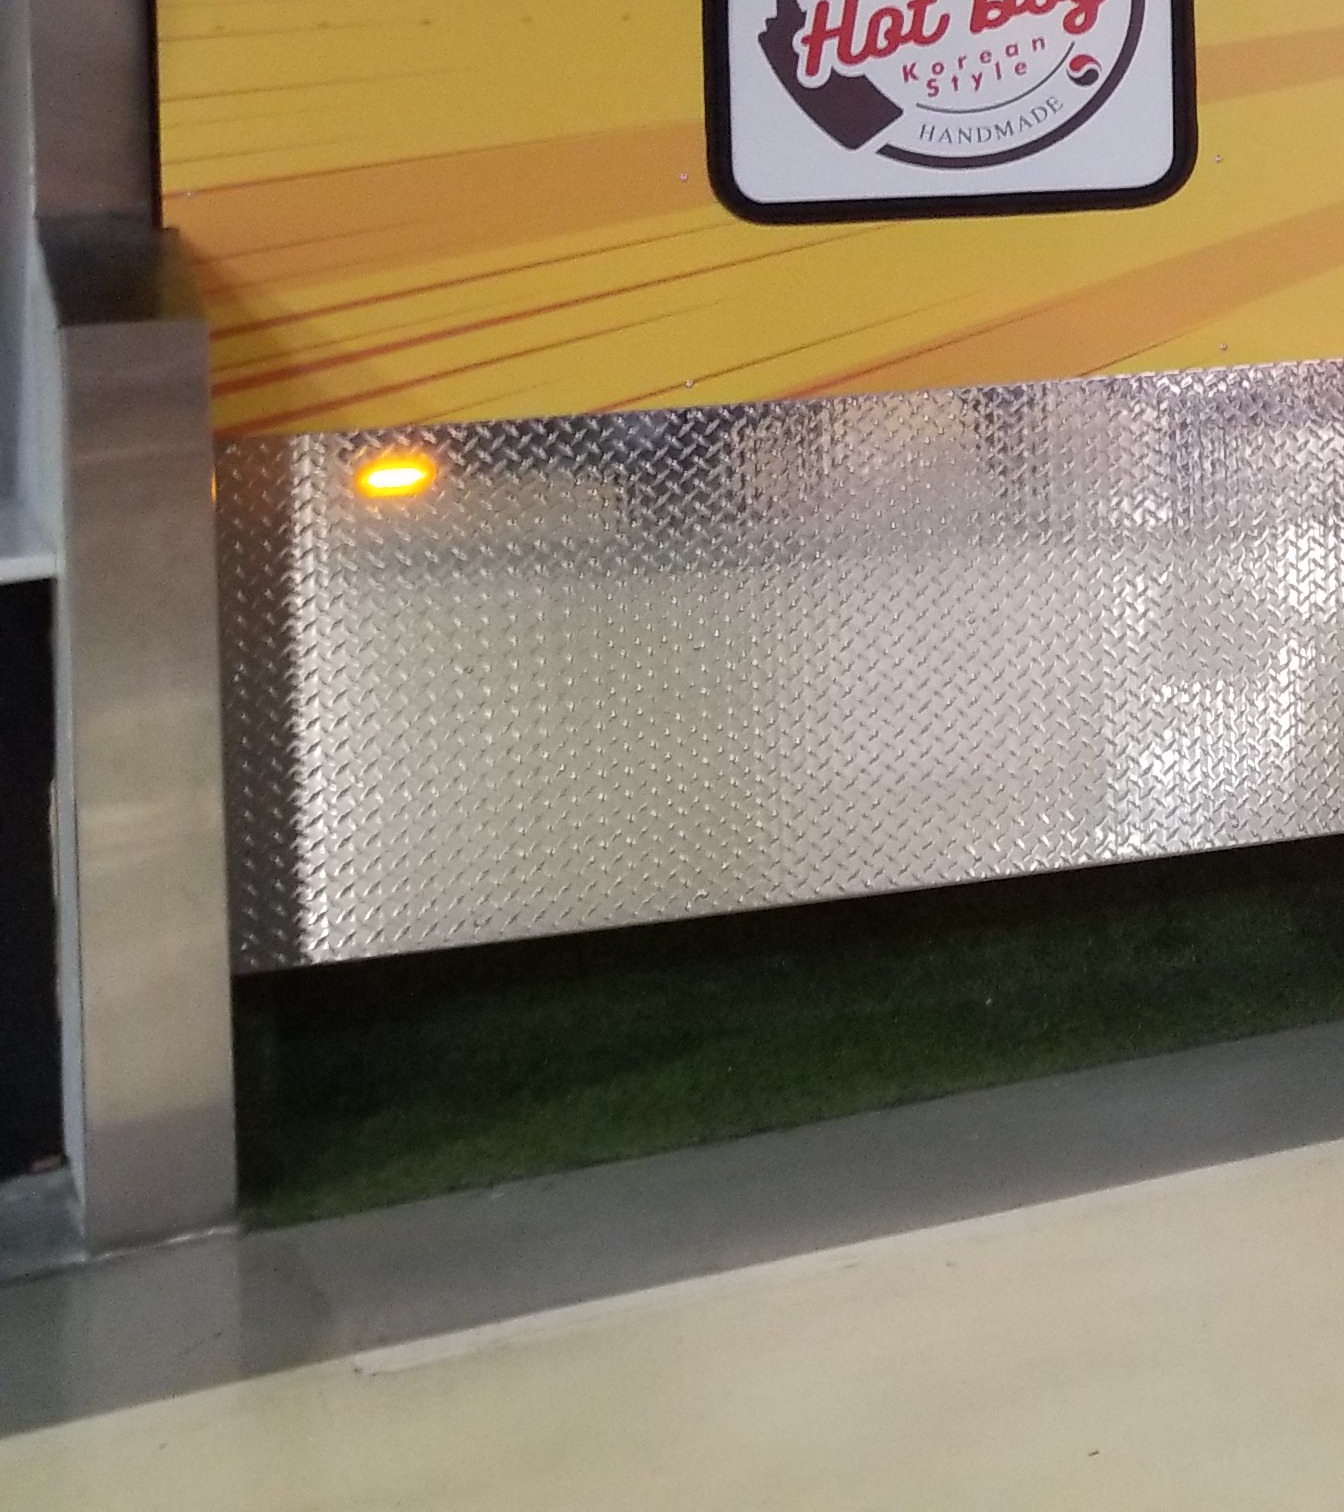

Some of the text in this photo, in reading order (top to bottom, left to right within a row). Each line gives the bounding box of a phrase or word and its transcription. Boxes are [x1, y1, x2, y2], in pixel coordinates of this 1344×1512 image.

[901, 36, 1048, 84] Korean
[925, 60, 1029, 98] Style
[918, 95, 1065, 146] HANDMADE
